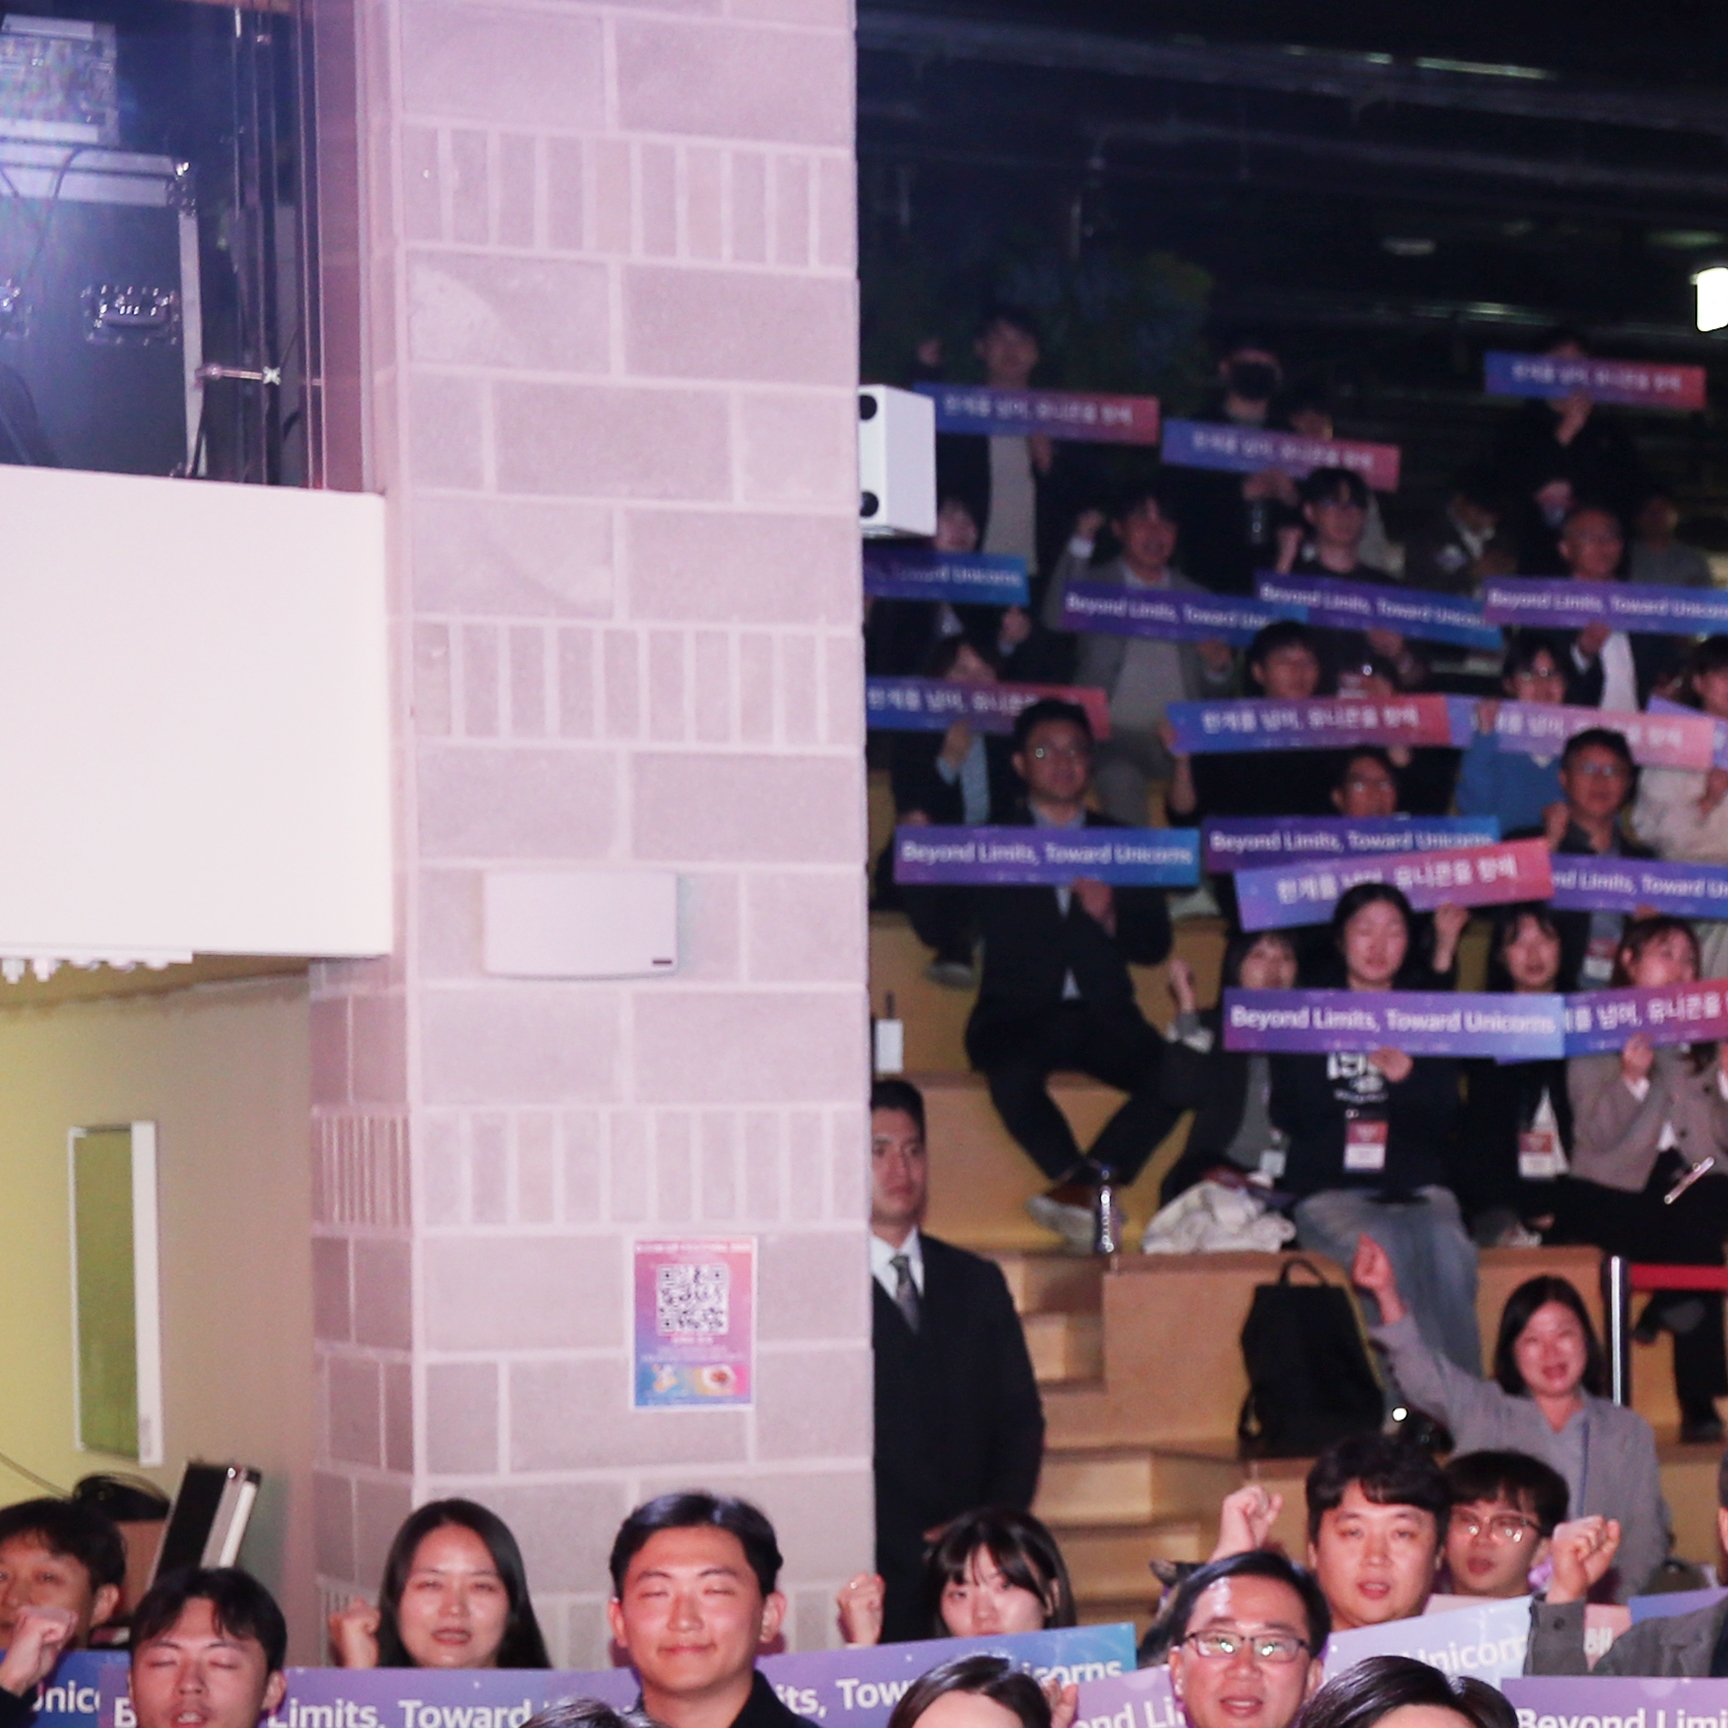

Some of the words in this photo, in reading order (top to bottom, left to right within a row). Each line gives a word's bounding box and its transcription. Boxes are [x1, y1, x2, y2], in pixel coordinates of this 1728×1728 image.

[1231, 1004, 1309, 1031] Beyond
[1312, 1005, 1381, 1034] Limits,
[1386, 1007, 1462, 1034] Toward
